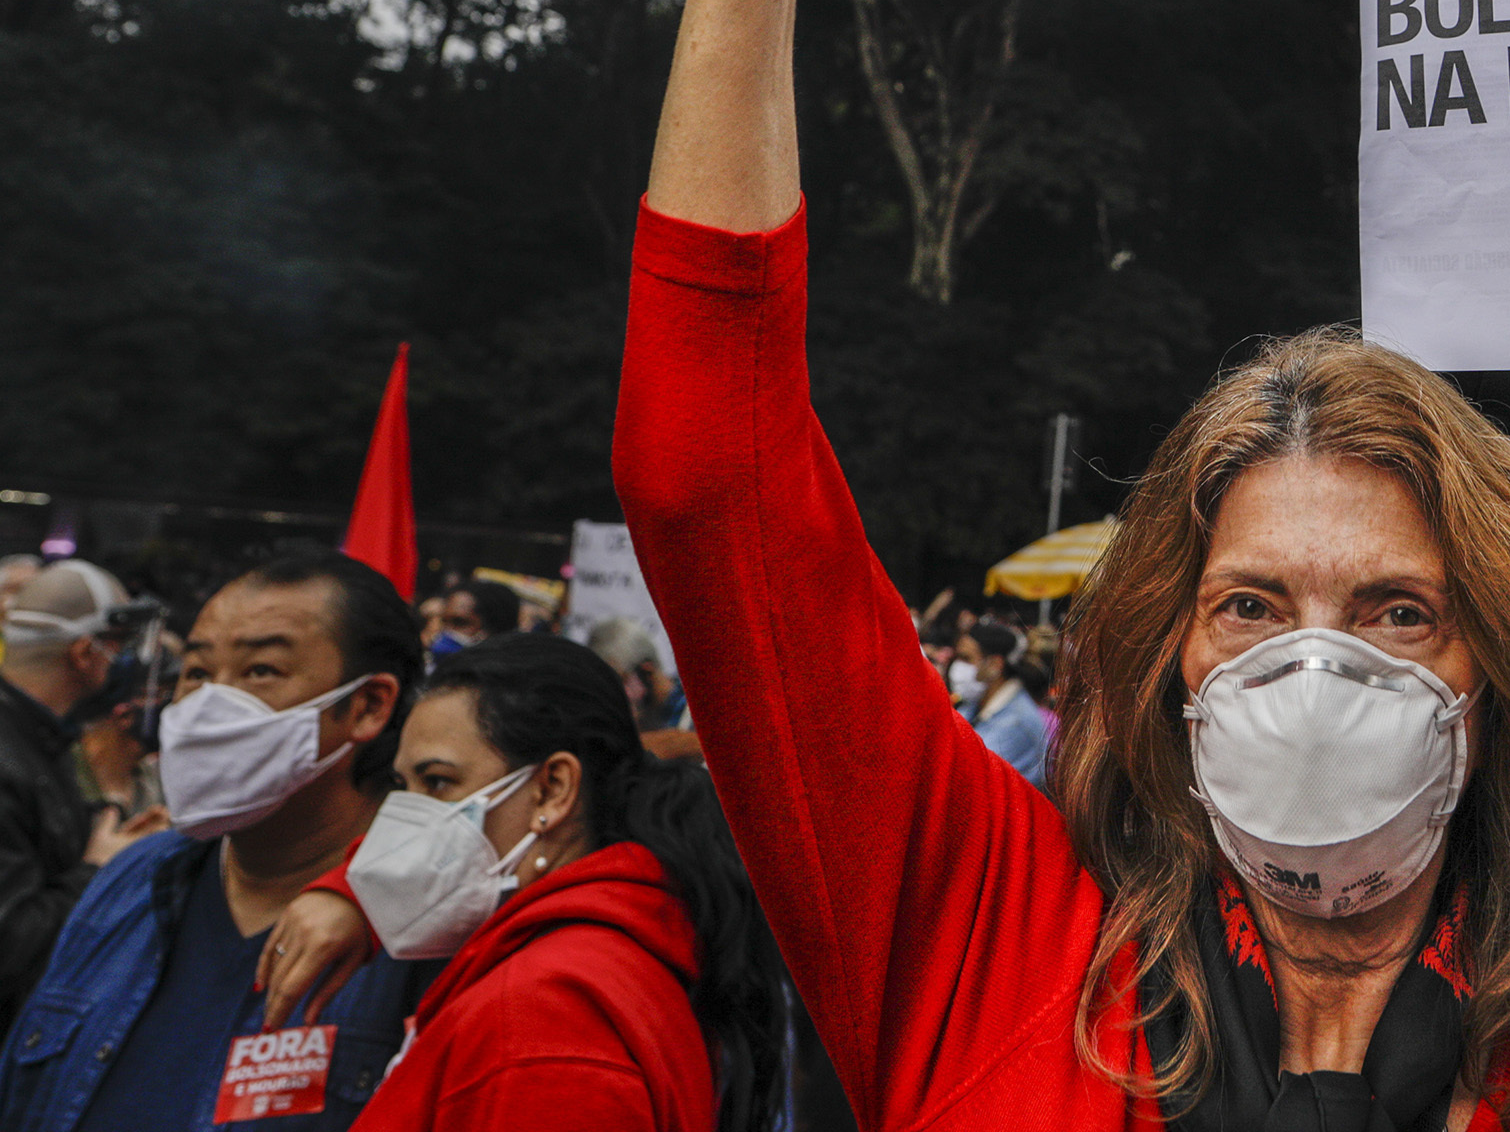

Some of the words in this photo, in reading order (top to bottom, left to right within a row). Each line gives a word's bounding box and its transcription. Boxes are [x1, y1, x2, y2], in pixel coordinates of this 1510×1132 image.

[1376, 49, 1487, 130] NA
[1263, 861, 1321, 889] 3M
[229, 1027, 328, 1067] FORA
